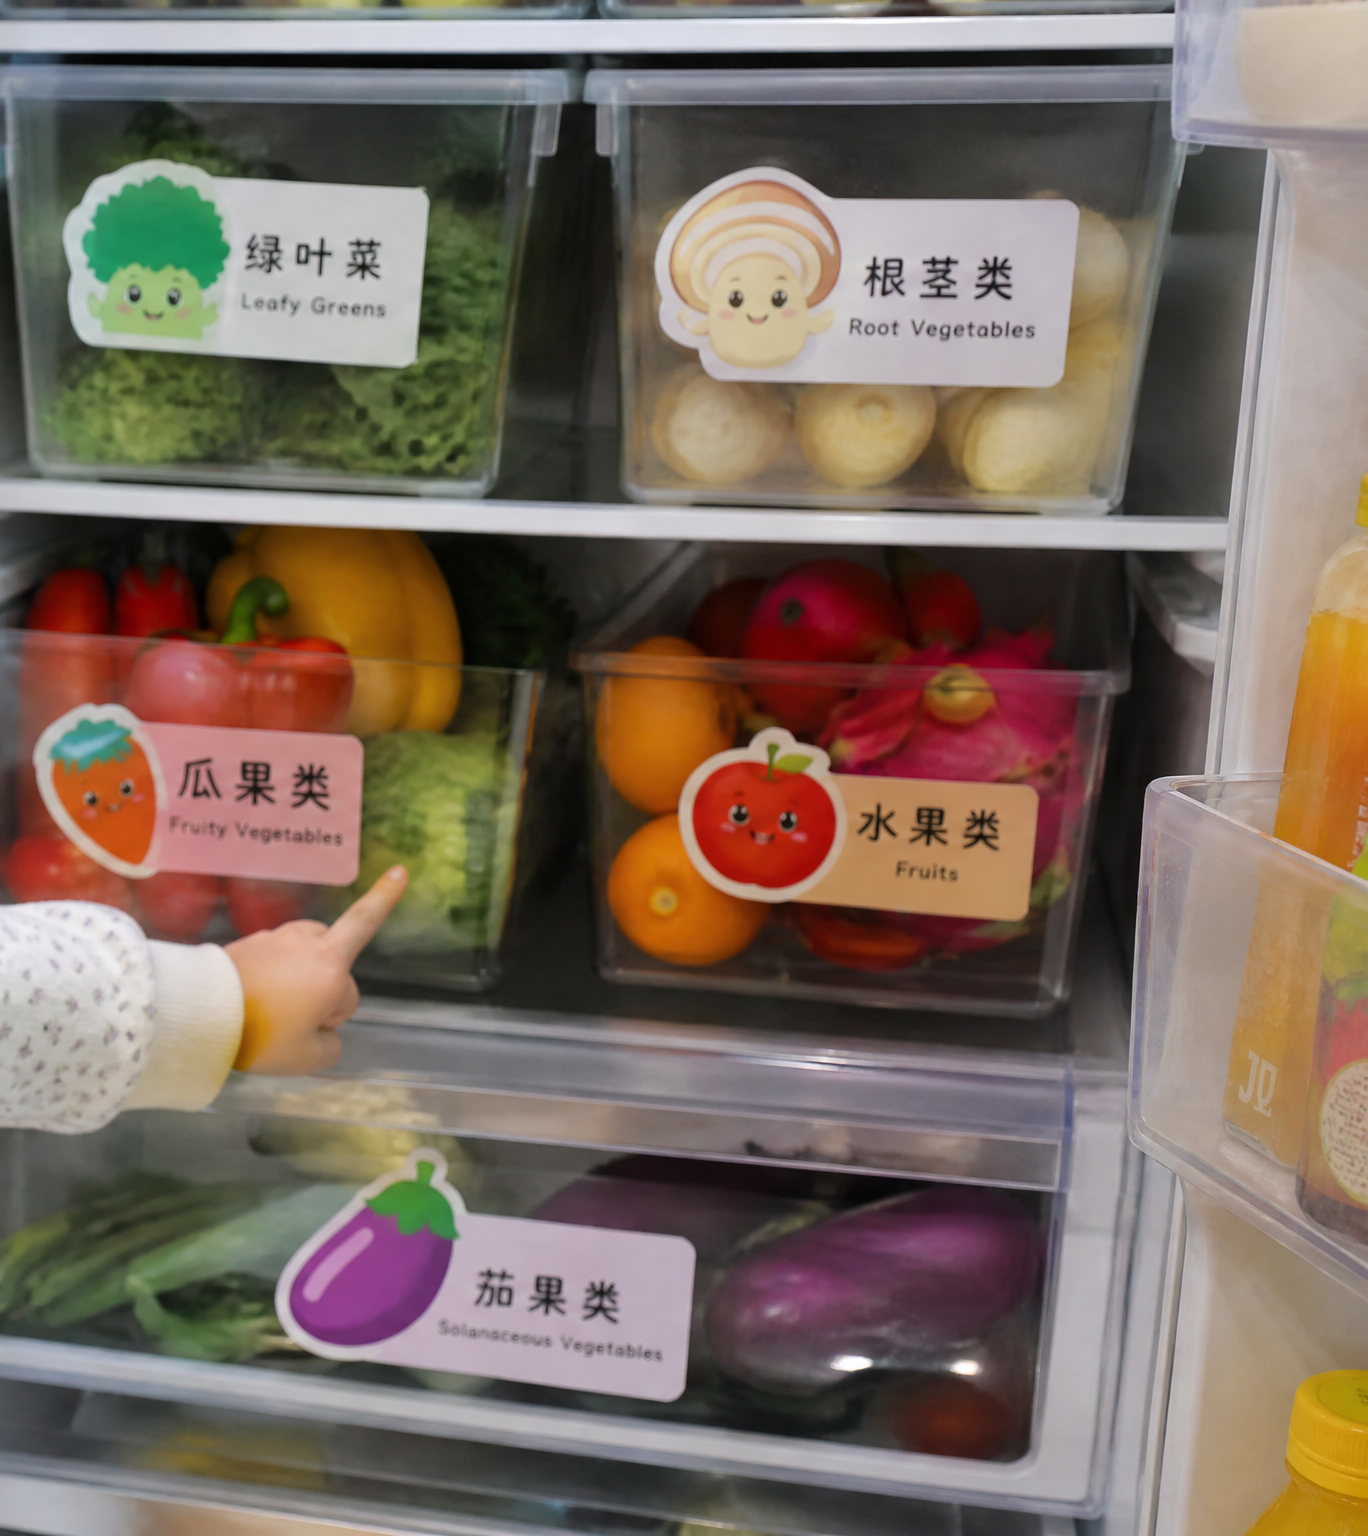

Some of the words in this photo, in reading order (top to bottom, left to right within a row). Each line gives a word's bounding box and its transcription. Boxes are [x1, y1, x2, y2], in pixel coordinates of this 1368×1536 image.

[244, 234, 382, 280] 绿叶菜
[863, 256, 1013, 300] 根茎类
[241, 292, 300, 317] Leafy
[310, 296, 387, 318] Greens
[848, 317, 900, 337] Root
[910, 319, 1036, 342] Vegetables
[177, 757, 330, 812] 瓜果类
[169, 815, 227, 840] Fruity
[234, 821, 343, 847] Vegetables
[857, 803, 1000, 851] 水果类
[895, 860, 959, 883] Fruits
[474, 1268, 620, 1324] 茄果类
[438, 1318, 553, 1348] Solanaceous
[559, 1335, 664, 1362] Vegetables
